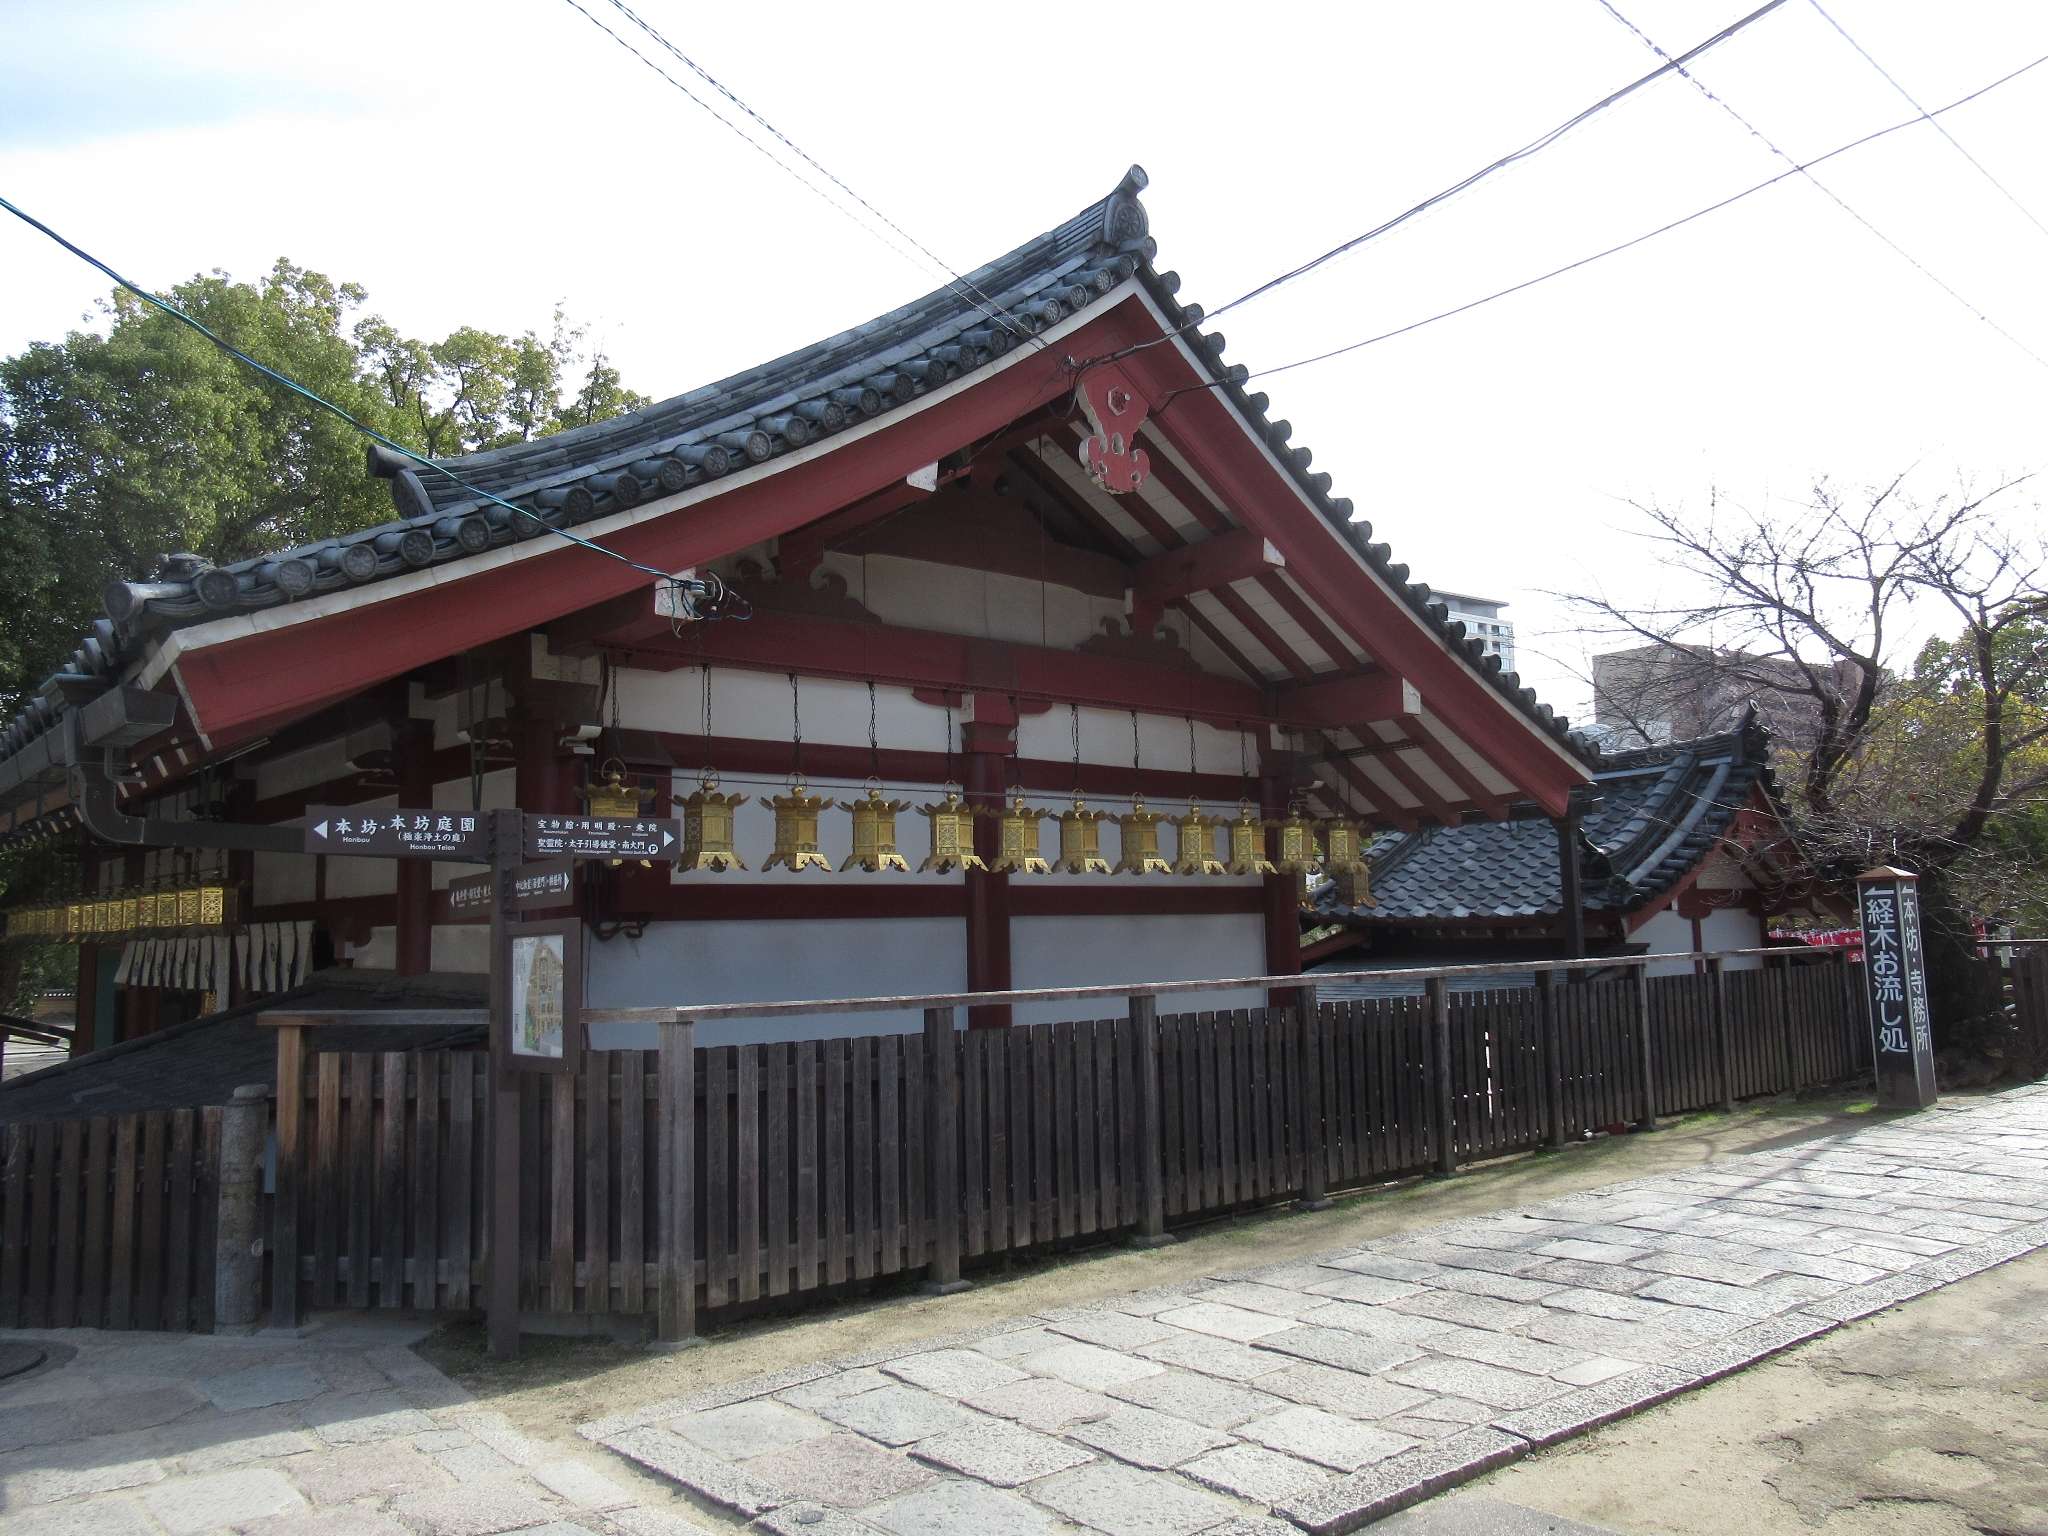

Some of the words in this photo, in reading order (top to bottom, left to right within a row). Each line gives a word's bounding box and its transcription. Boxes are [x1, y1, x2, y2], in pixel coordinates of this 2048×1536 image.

[1865, 898, 1909, 1053] 経木お流し処
[1903, 899, 1928, 1051] 本坊・寺務所
